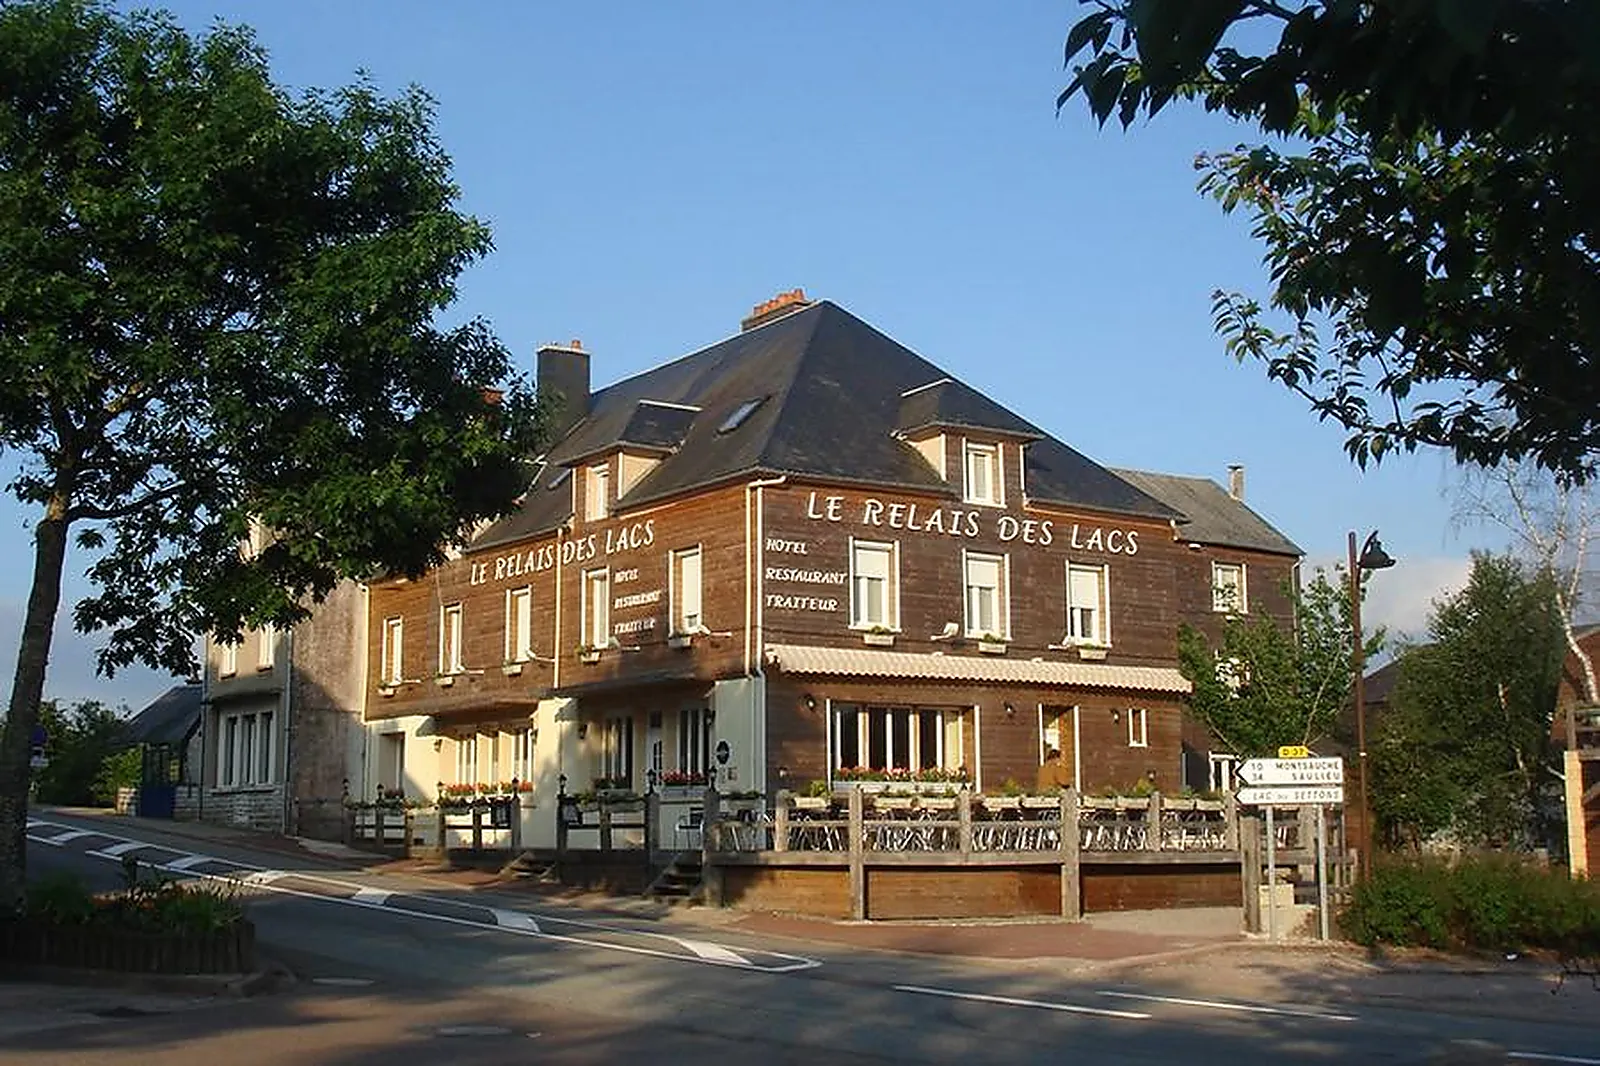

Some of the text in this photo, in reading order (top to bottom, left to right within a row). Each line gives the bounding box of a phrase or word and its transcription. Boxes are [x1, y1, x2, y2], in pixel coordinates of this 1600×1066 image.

[807, 492, 1139, 556] LE RELAIS DES LACS
[470, 519, 655, 586] LE RELAIS DES LACS
[765, 538, 809, 556] HOTEL
[765, 567, 848, 586] RESTAURANT
[765, 594, 839, 612] TRAITEUR
[1275, 761, 1339, 770] MONTSAUCHE
[1292, 772, 1340, 780] SAULIEU
